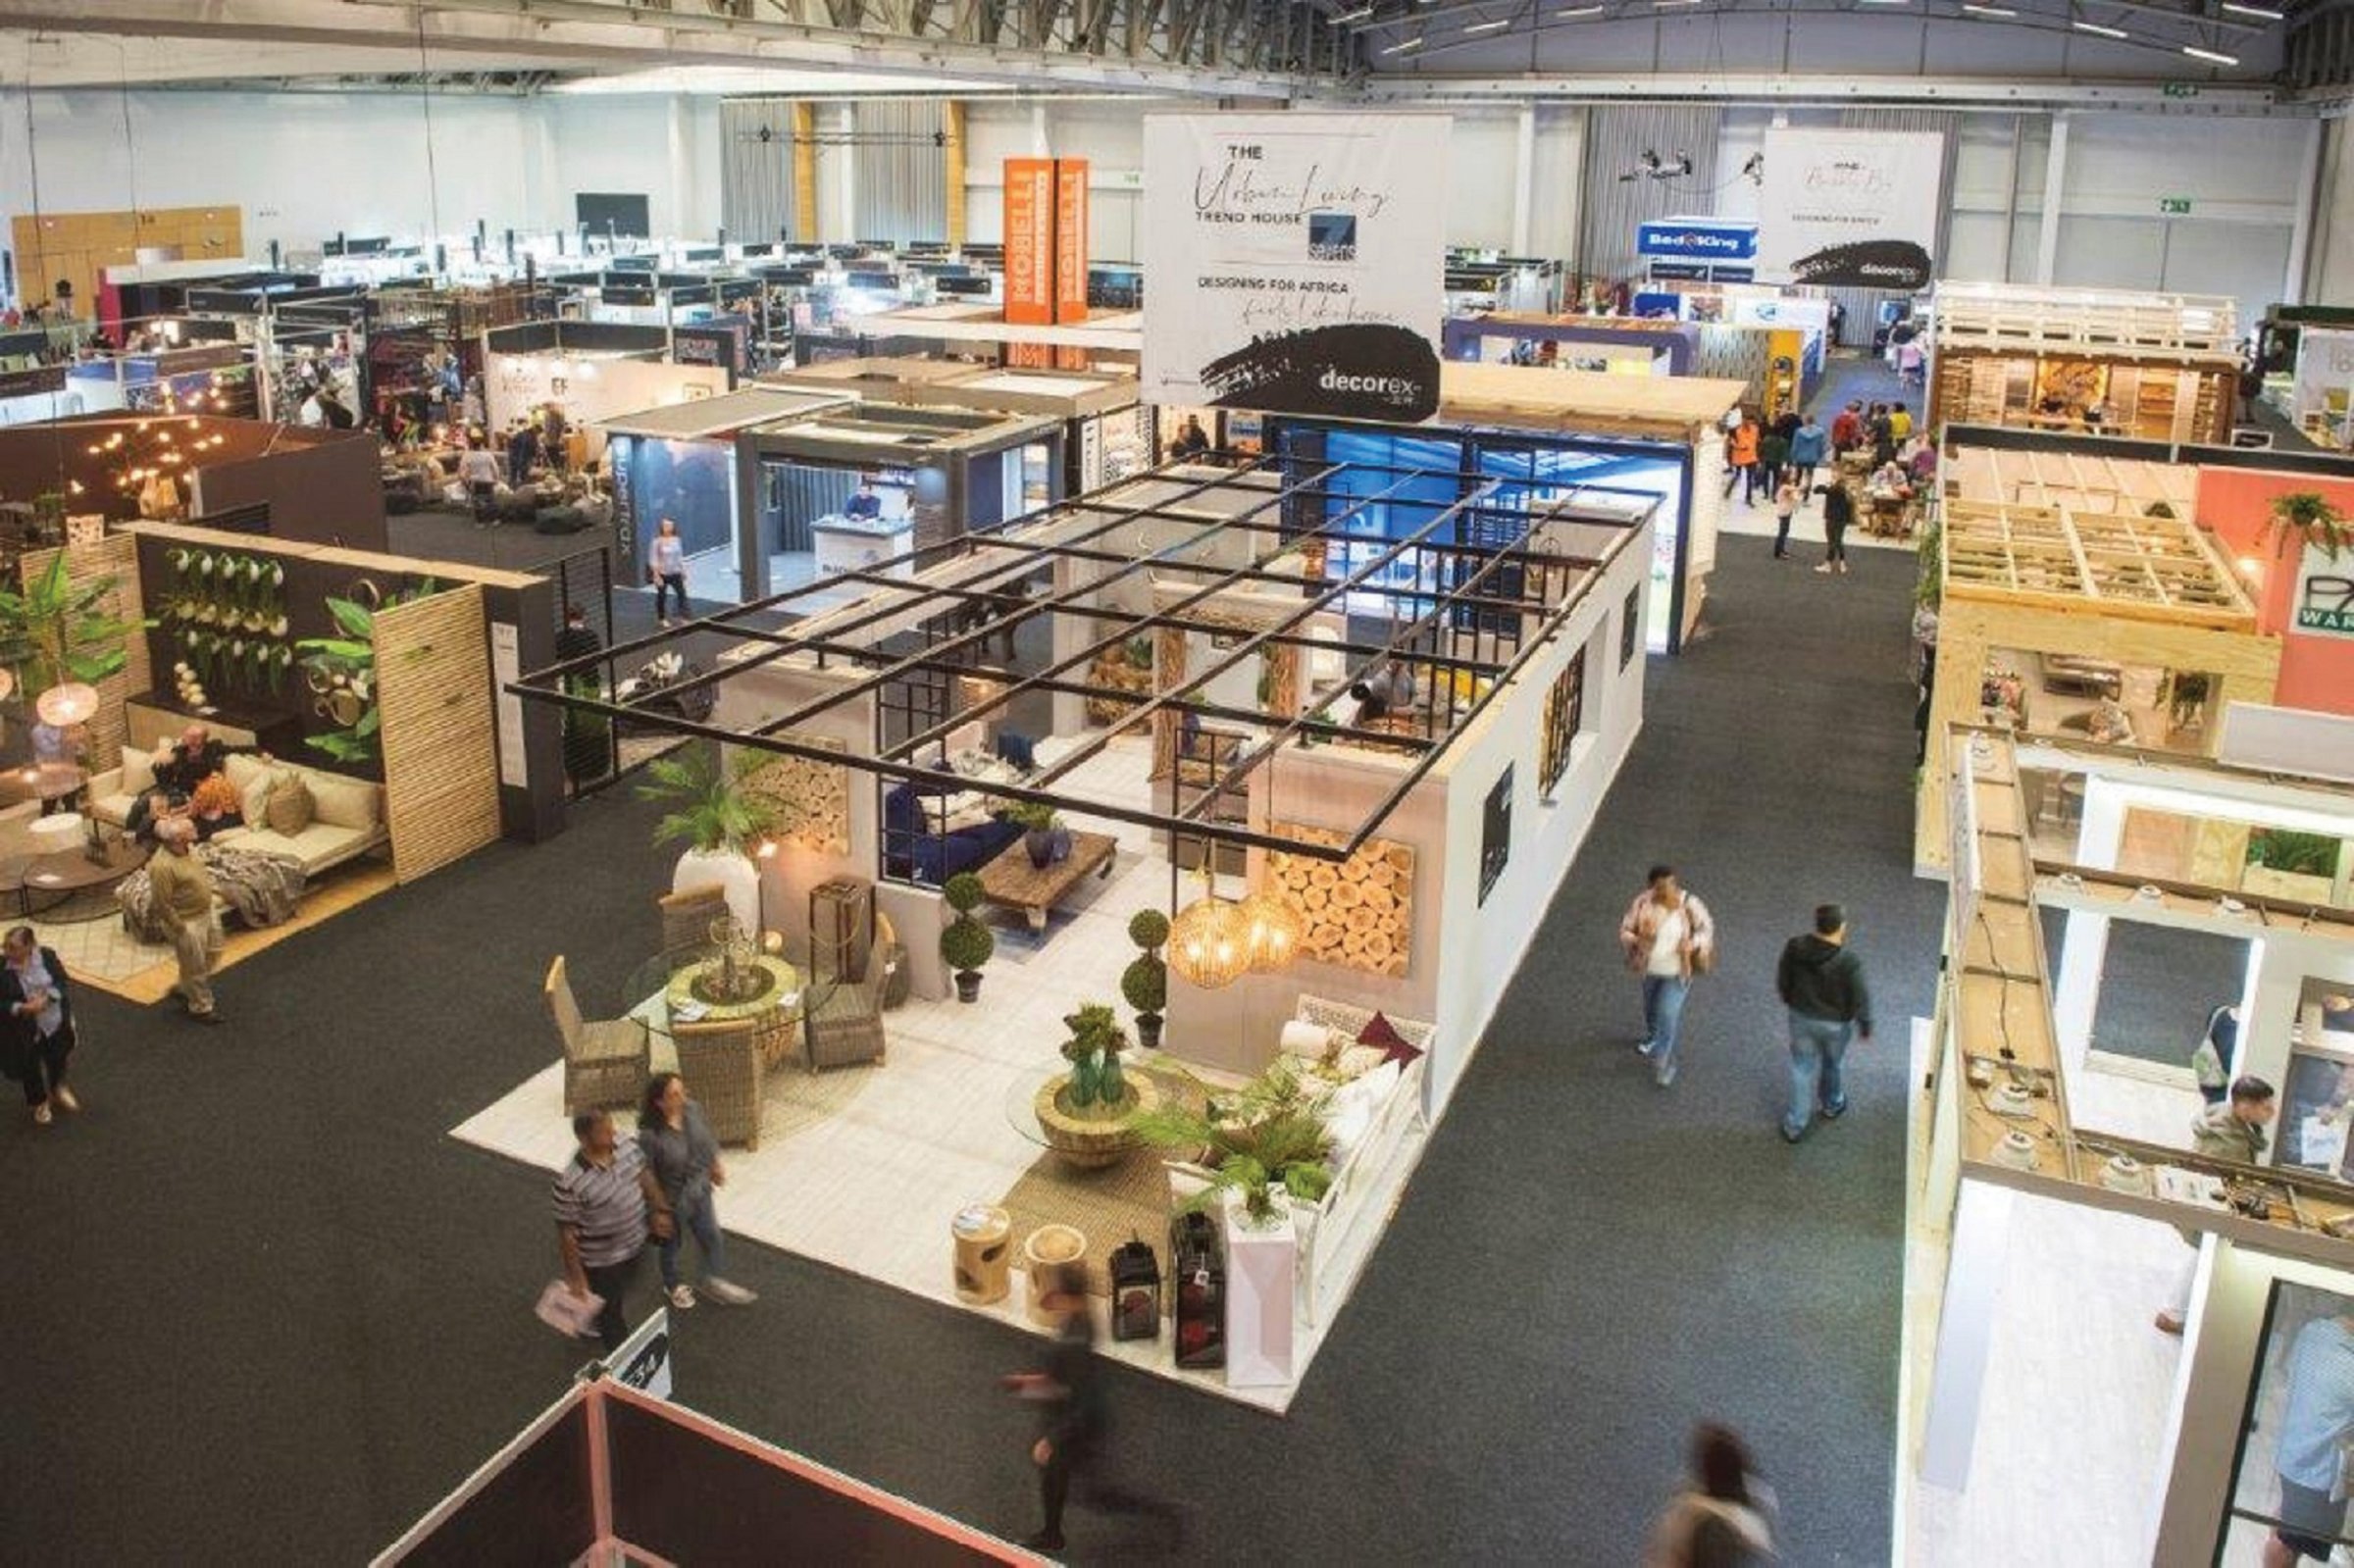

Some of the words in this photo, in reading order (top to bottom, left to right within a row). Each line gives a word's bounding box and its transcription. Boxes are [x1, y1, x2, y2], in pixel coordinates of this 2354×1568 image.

[1227, 146, 1262, 160] THE
[1196, 212, 1245, 224] TREND
[1252, 213, 1303, 225] HOUSE
[1010, 171, 1033, 302] MOBELLI
[1649, 233, 1684, 245] Bed
[1697, 235, 1739, 250] King
[1198, 277, 1265, 291] DESIGNING
[1270, 279, 1295, 292] FOR
[1300, 281, 1349, 294] AFRICA
[1319, 369, 1414, 395] decorex
